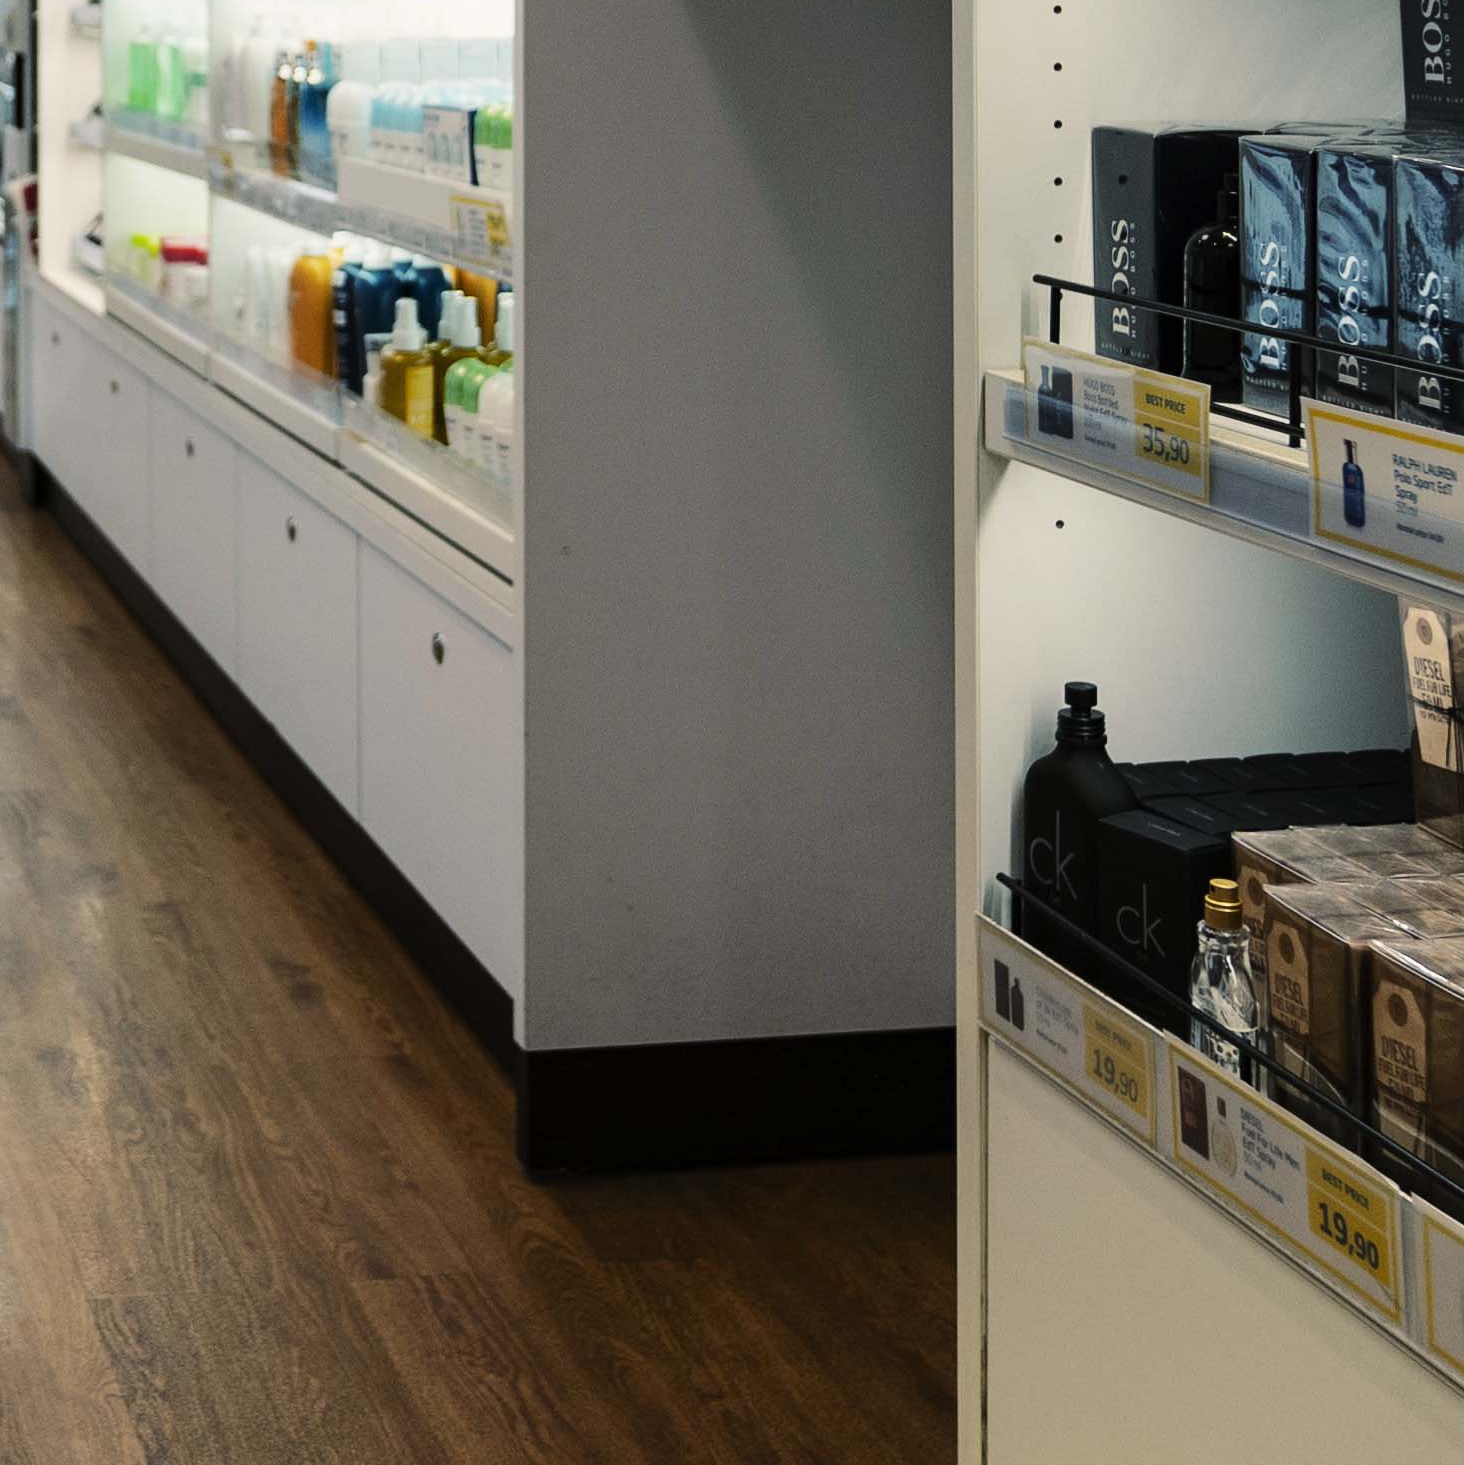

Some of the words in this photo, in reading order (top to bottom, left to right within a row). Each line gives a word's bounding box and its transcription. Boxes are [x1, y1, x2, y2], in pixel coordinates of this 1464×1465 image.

[1259, 241, 1280, 371] BOSS
[1337, 255, 1361, 386] BOSS
[1146, 393, 1164, 409] BEST
[1165, 398, 1186, 415] PRICE
[1142, 423, 1189, 464] 35,90
[1392, 453, 1420, 472] RALPH
[1422, 460, 1458, 482] LAUREN
[1393, 469, 1411, 484] Polo
[1395, 485, 1417, 505] Spray
[1413, 655, 1446, 683] DIESEL
[1412, 678, 1426, 692] FUEL
[1438, 683, 1453, 697] LIFE
[1029, 810, 1078, 901] ck
[1116, 882, 1166, 958] ck
[1274, 973, 1304, 1007] DIESEL
[1381, 1036, 1419, 1072] DIESEL
[1093, 1049, 1138, 1103] 19,90
[1240, 1107, 1264, 1133] DIESEL
[1322, 1168, 1343, 1190] BEST
[1346, 1181, 1369, 1211] PRICE
[1319, 1202, 1379, 1270] 19,90
